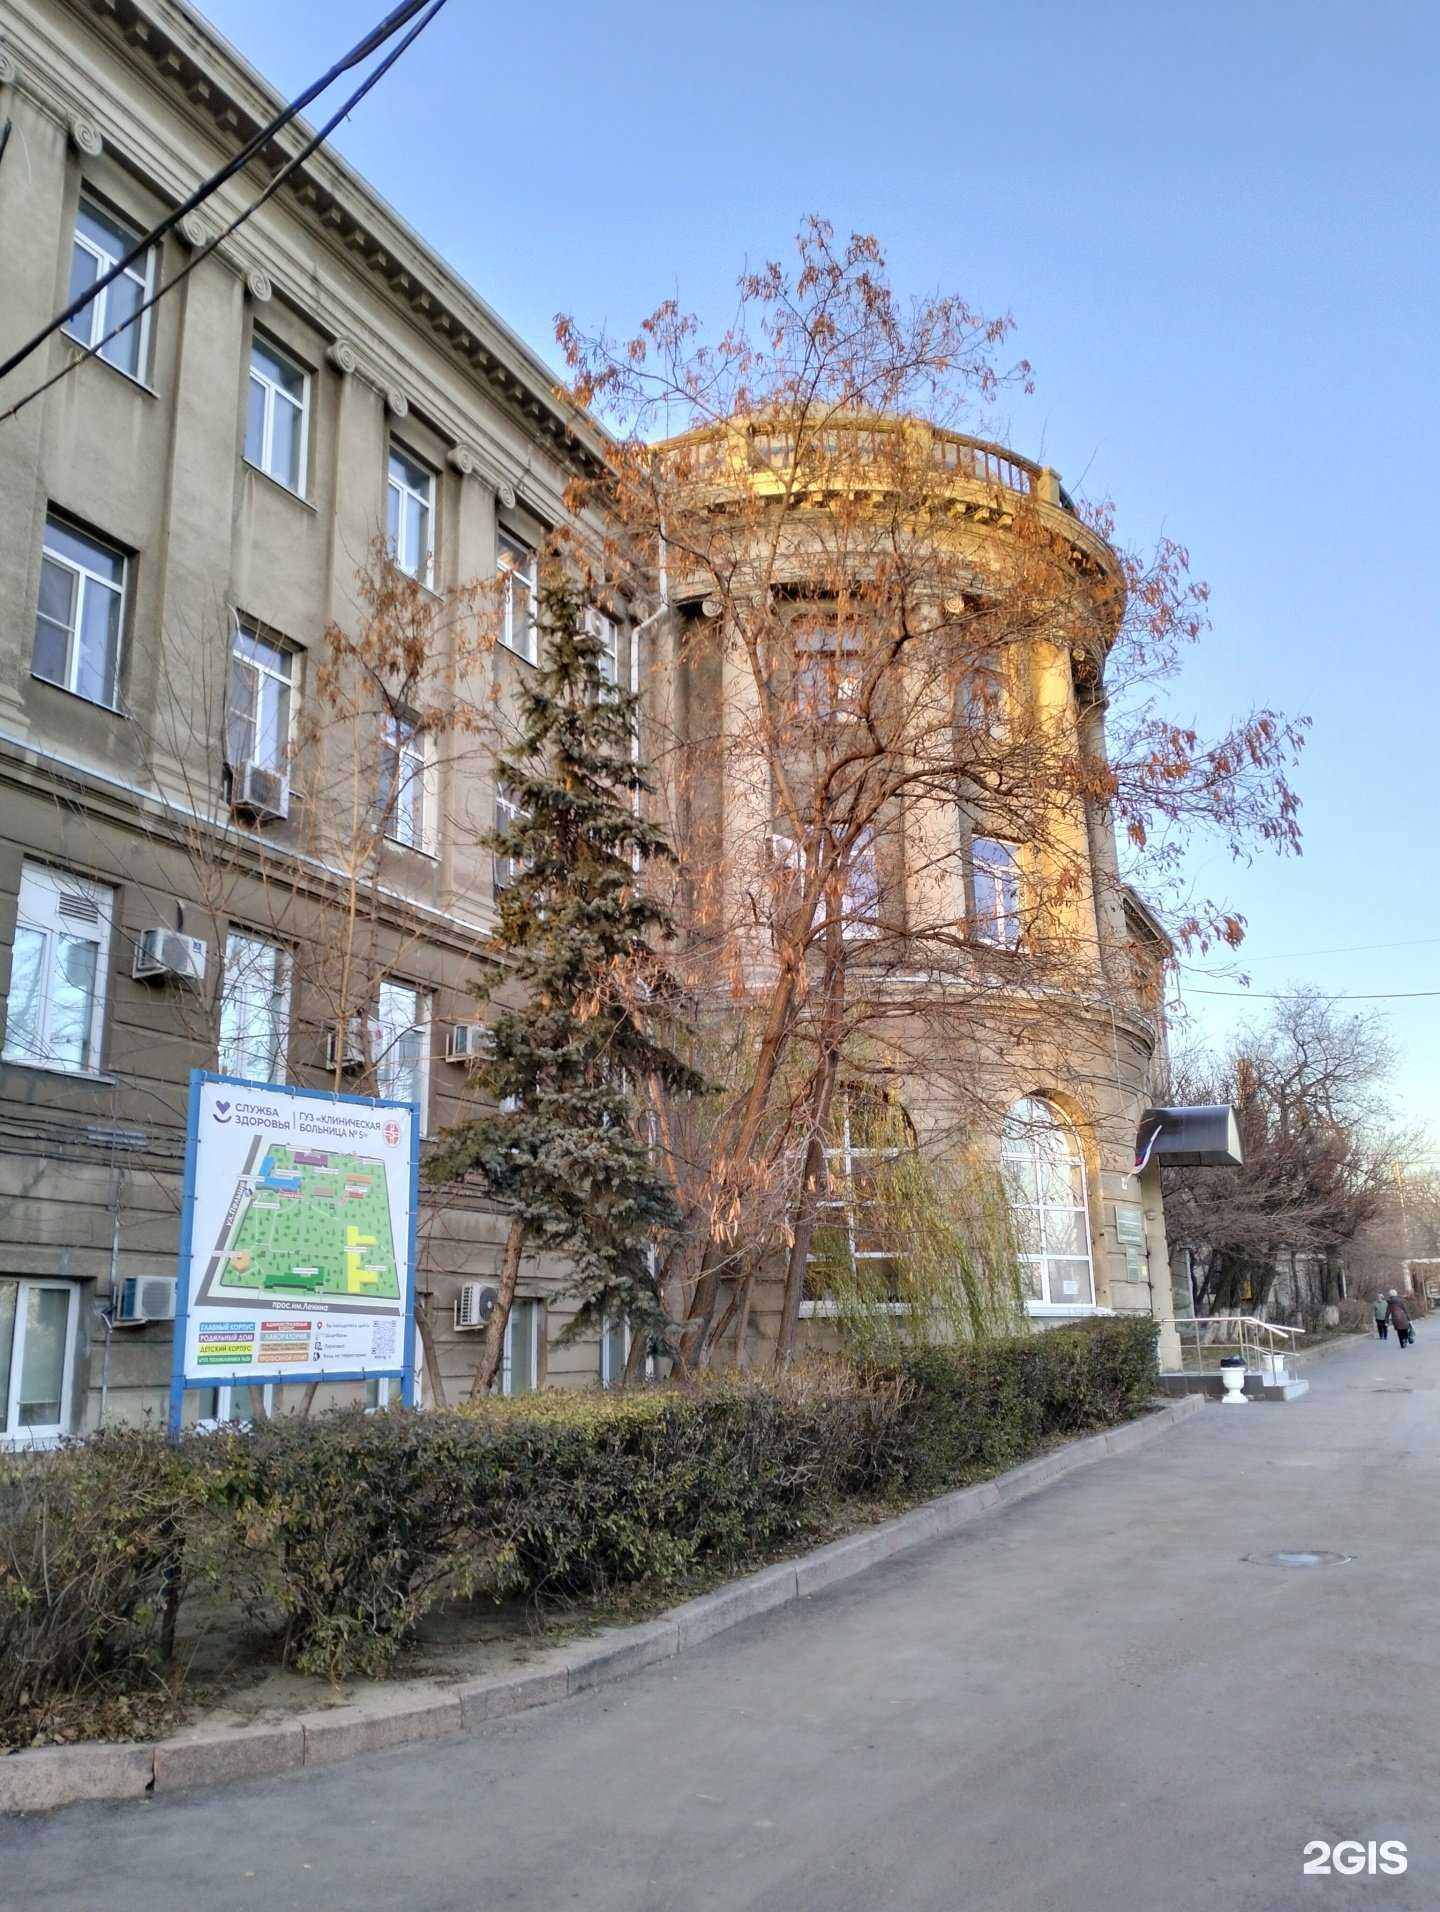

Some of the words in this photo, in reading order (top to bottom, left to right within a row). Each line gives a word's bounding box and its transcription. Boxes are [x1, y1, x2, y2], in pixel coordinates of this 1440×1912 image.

[235, 1103, 279, 1117] СЛУЖБА
[235, 1115, 290, 1130] ЗДОРОВЬЯ
[299, 1112, 315, 1122] ГУЗ
[316, 1115, 381, 1130] «КЛИНИЧЕСКАЯ
[299, 1123, 347, 1138] БОЛЬНИЦА
[238, 1333, 253, 1341] ДОМ
[200, 1344, 227, 1353] ДЕТСКИЙ
[228, 1344, 252, 1352] КОРПУС
